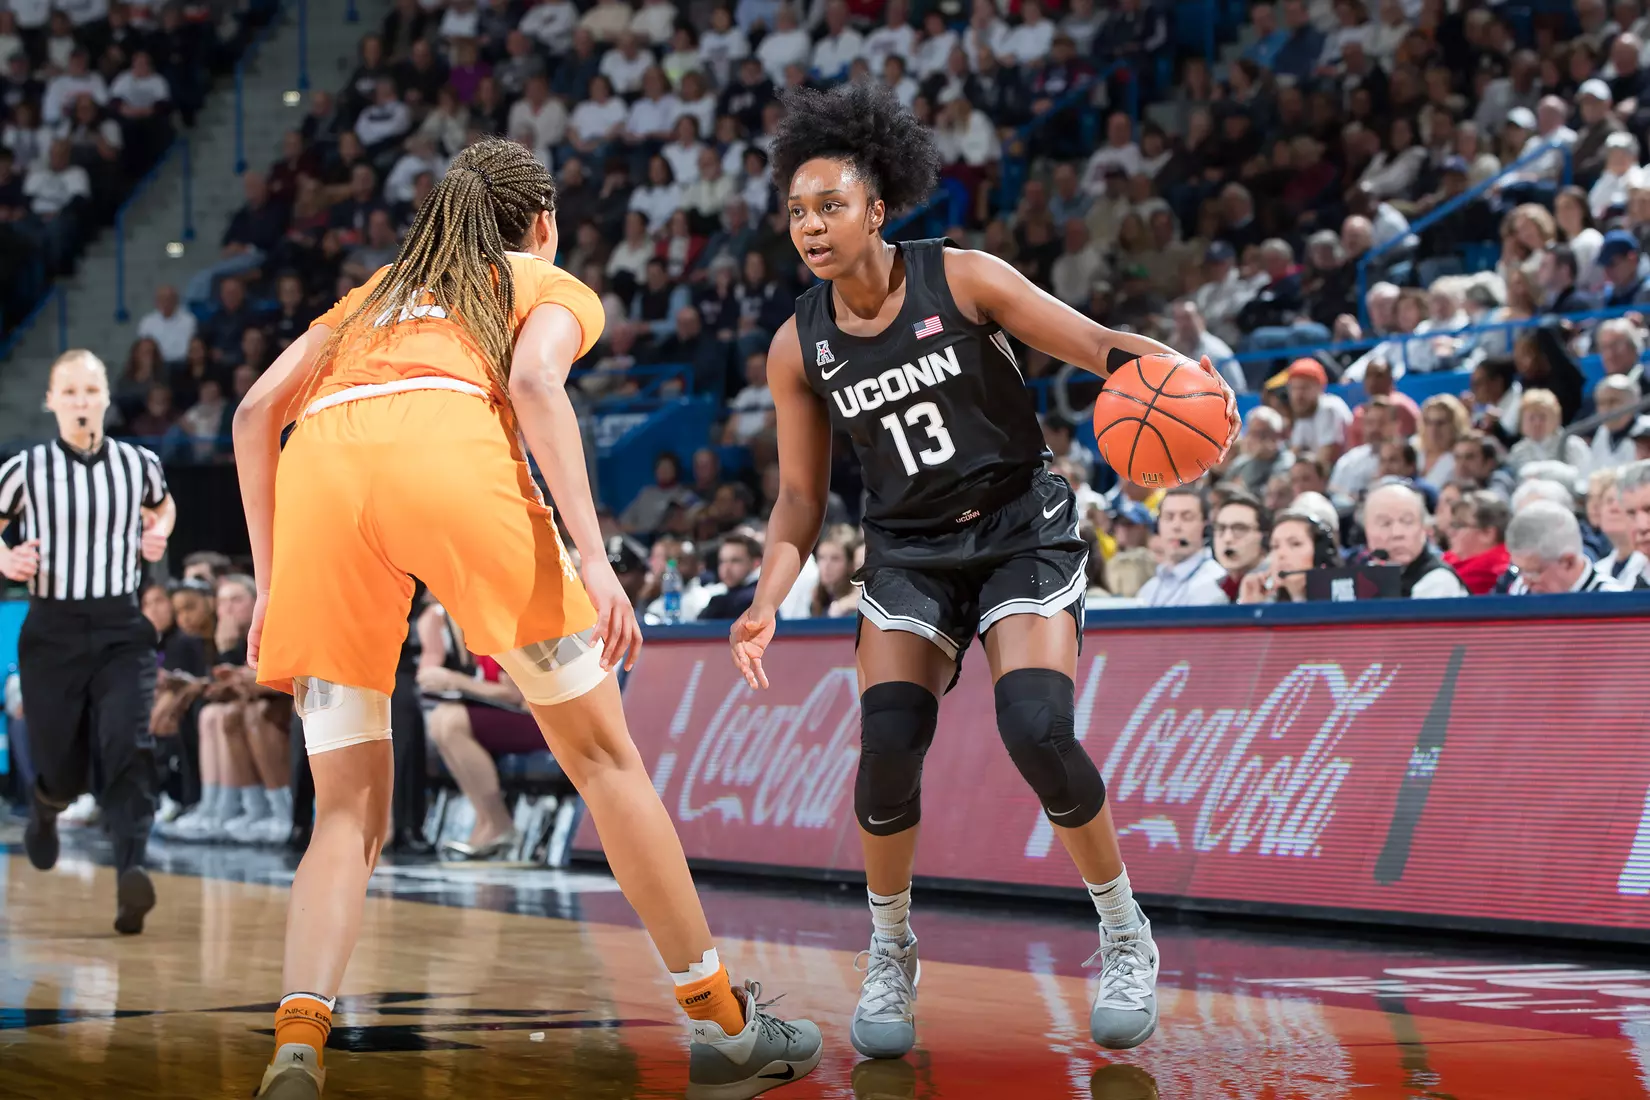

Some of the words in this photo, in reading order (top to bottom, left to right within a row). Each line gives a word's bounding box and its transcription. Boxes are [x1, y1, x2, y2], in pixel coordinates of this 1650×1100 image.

[831, 345, 962, 418] UCONN
[880, 401, 956, 477] 13
[955, 510, 980, 523] UCONN
[685, 990, 711, 1005] GRIP
